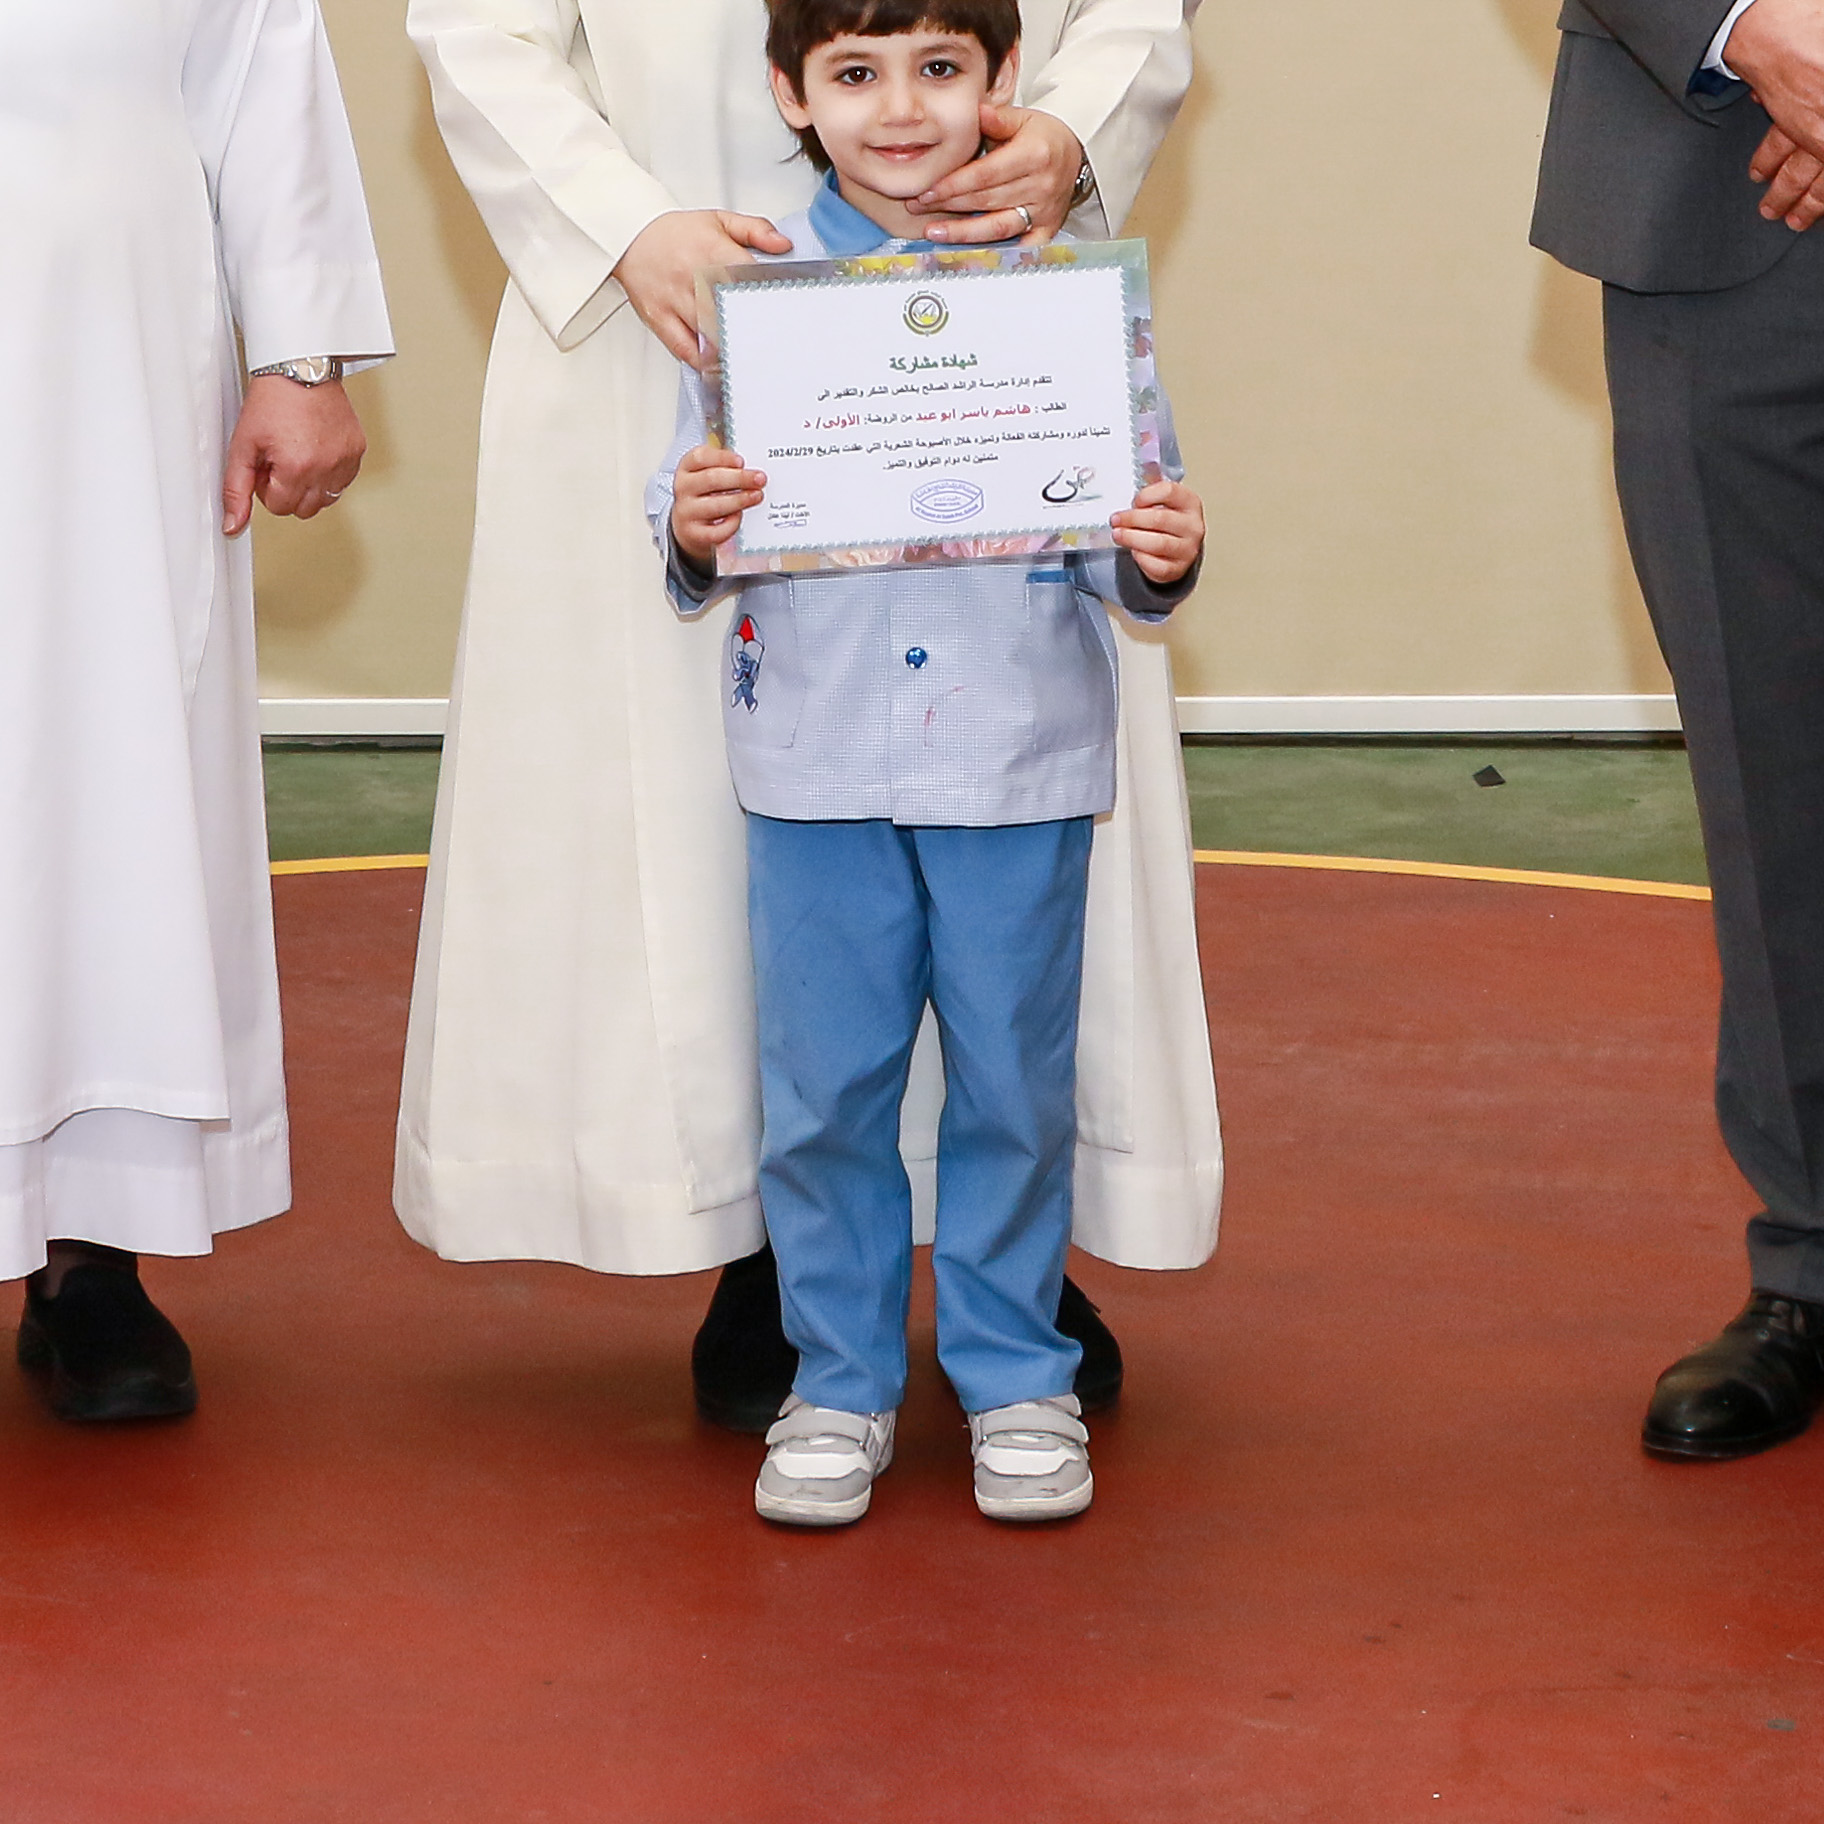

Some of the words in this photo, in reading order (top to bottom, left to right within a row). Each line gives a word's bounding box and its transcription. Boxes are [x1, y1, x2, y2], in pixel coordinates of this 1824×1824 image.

[889, 355, 939, 374] مشاركة
[941, 353, 978, 370] شهادة
[921, 382, 949, 395] الصالح
[979, 378, 1009, 389] مدرسة
[891, 384, 920, 396] بخالص
[993, 403, 1031, 419] هاشم
[1041, 401, 1067, 413] الطالب
[900, 414, 912, 423] من
[767, 446, 814, 458] 2024/2/29
